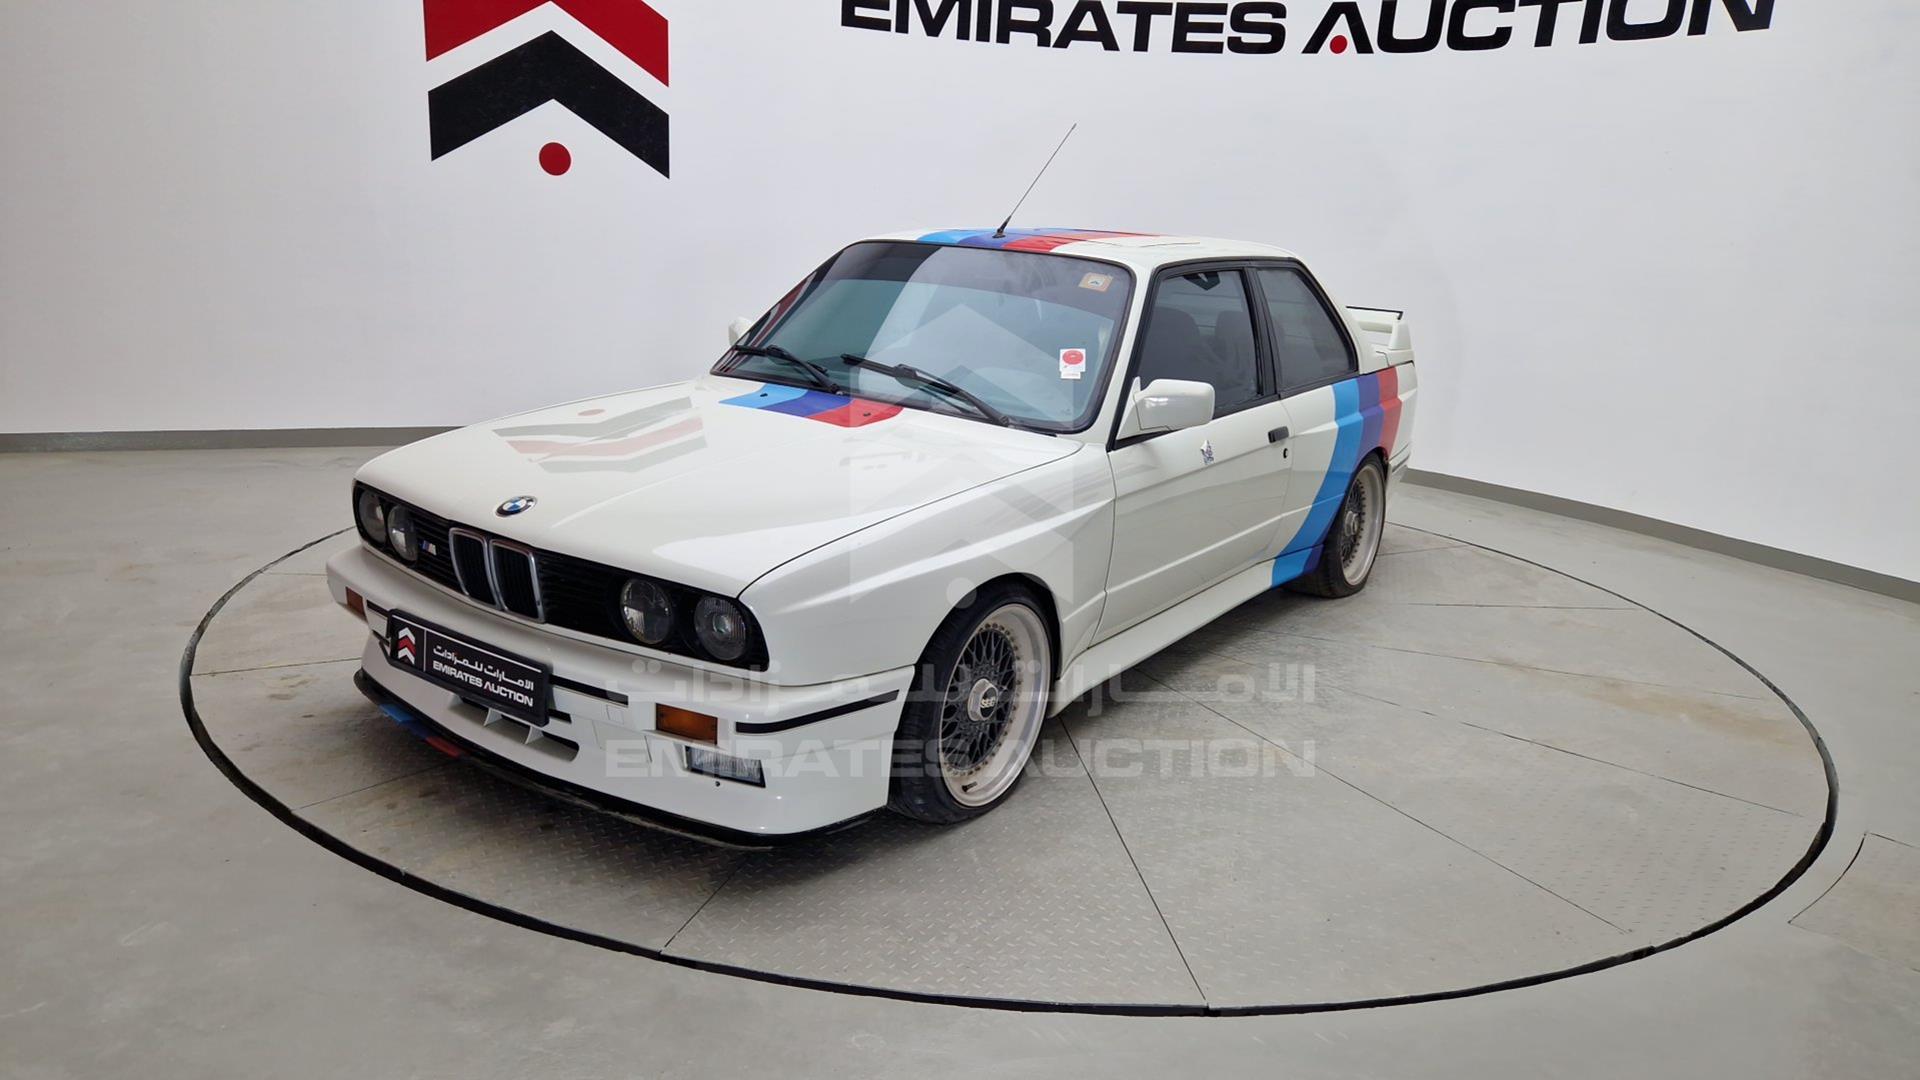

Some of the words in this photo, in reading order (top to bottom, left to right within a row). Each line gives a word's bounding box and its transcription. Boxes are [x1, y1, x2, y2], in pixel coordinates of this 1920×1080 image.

[841, 0, 1287, 54] EMIRATES
[1301, 0, 1775, 54] AUCTION
[432, 660, 482, 687] EMIRATES
[484, 681, 533, 707] AUCTION
